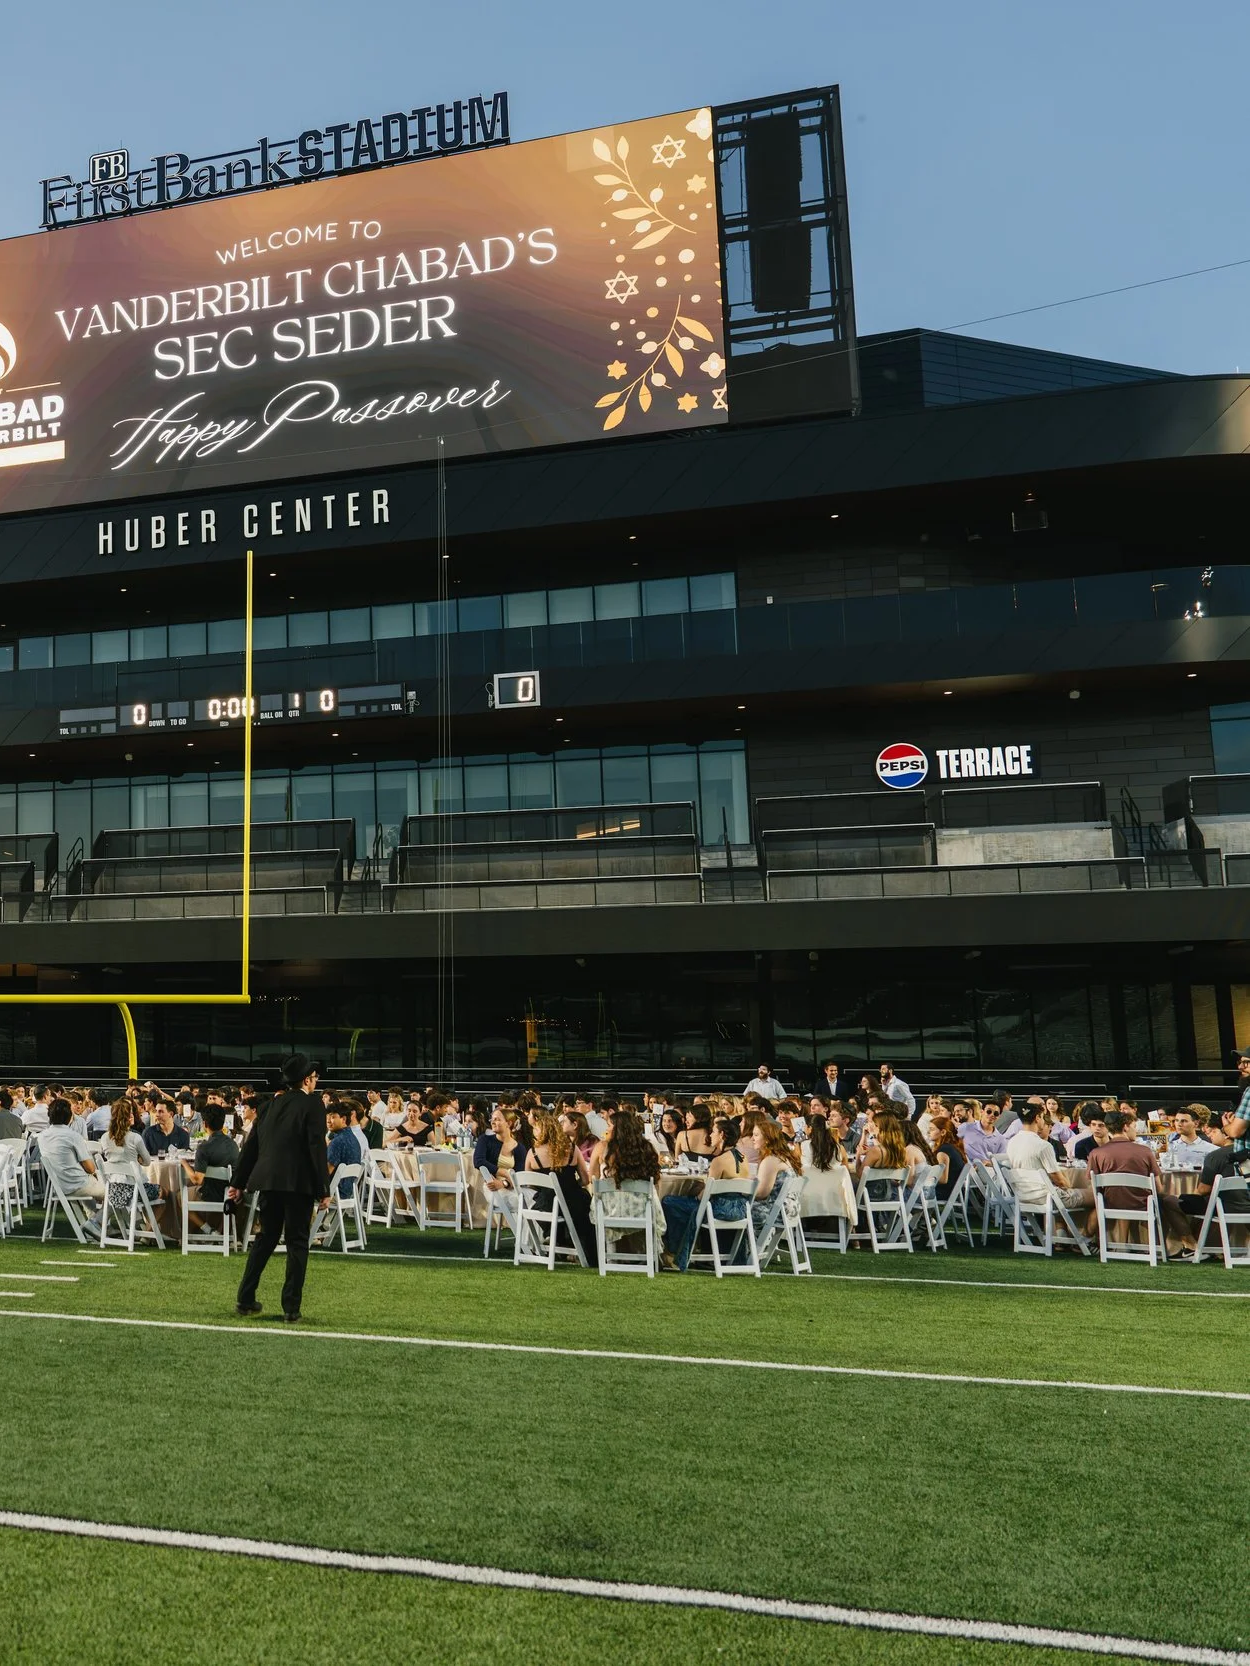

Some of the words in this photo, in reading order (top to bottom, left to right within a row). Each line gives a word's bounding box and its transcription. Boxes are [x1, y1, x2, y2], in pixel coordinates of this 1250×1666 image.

[297, 91, 508, 178] STADIUM
[92, 153, 126, 182] FB
[215, 223, 338, 265] WELCOME
[350, 221, 382, 240] TO
[55, 268, 312, 341] VANDERBILT
[153, 326, 258, 380] SEC
[272, 294, 458, 362] SEDER
[109, 391, 257, 471] Happy
[237, 379, 512, 454] Passover
[98, 509, 217, 555] HUBER
[243, 488, 391, 539] CENTER
[320, 689, 335, 712] 0
[517, 677, 534, 702] 0
[133, 703, 146, 725] 0
[260, 711, 273, 720] BALL
[274, 711, 283, 719] ON
[390, 703, 402, 711] TOL
[148, 719, 165, 727] DOWN
[178, 718, 187, 726] GO
[879, 760, 925, 772] PEPSI
[936, 745, 1033, 779] TERRACE
